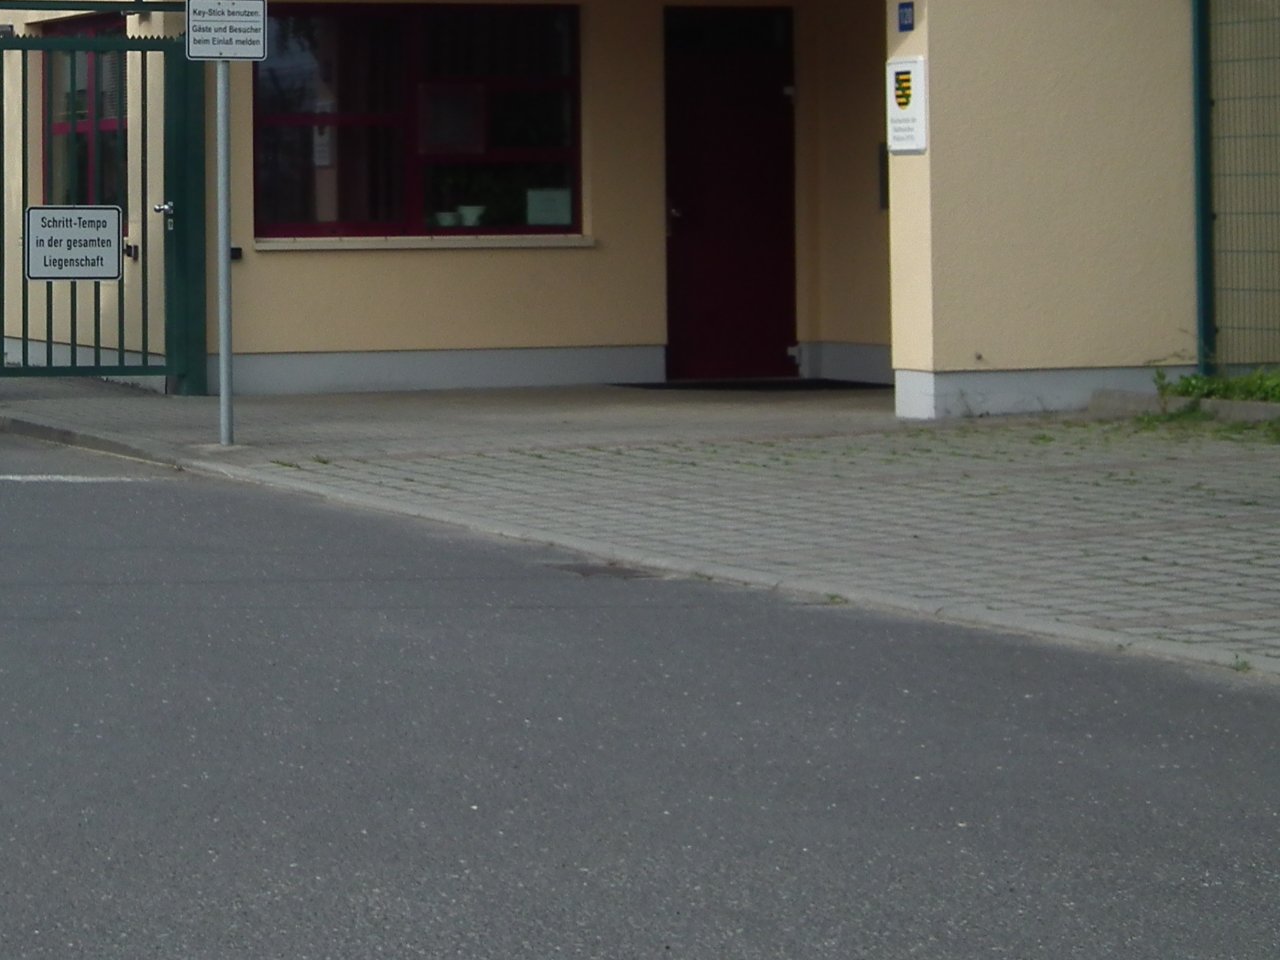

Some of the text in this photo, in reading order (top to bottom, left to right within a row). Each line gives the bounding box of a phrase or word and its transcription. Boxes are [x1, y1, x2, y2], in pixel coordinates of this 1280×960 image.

[192, 8, 226, 18] Key-Stick
[191, 24, 262, 33] Gäste und Besucher
[192, 37, 210, 45] beim
[211, 37, 233, 45] Einlaß
[40, 216, 108, 231] Schritt-Tempo
[35, 236, 112, 251] in der gesamten
[43, 255, 104, 270] Liegenschaft
